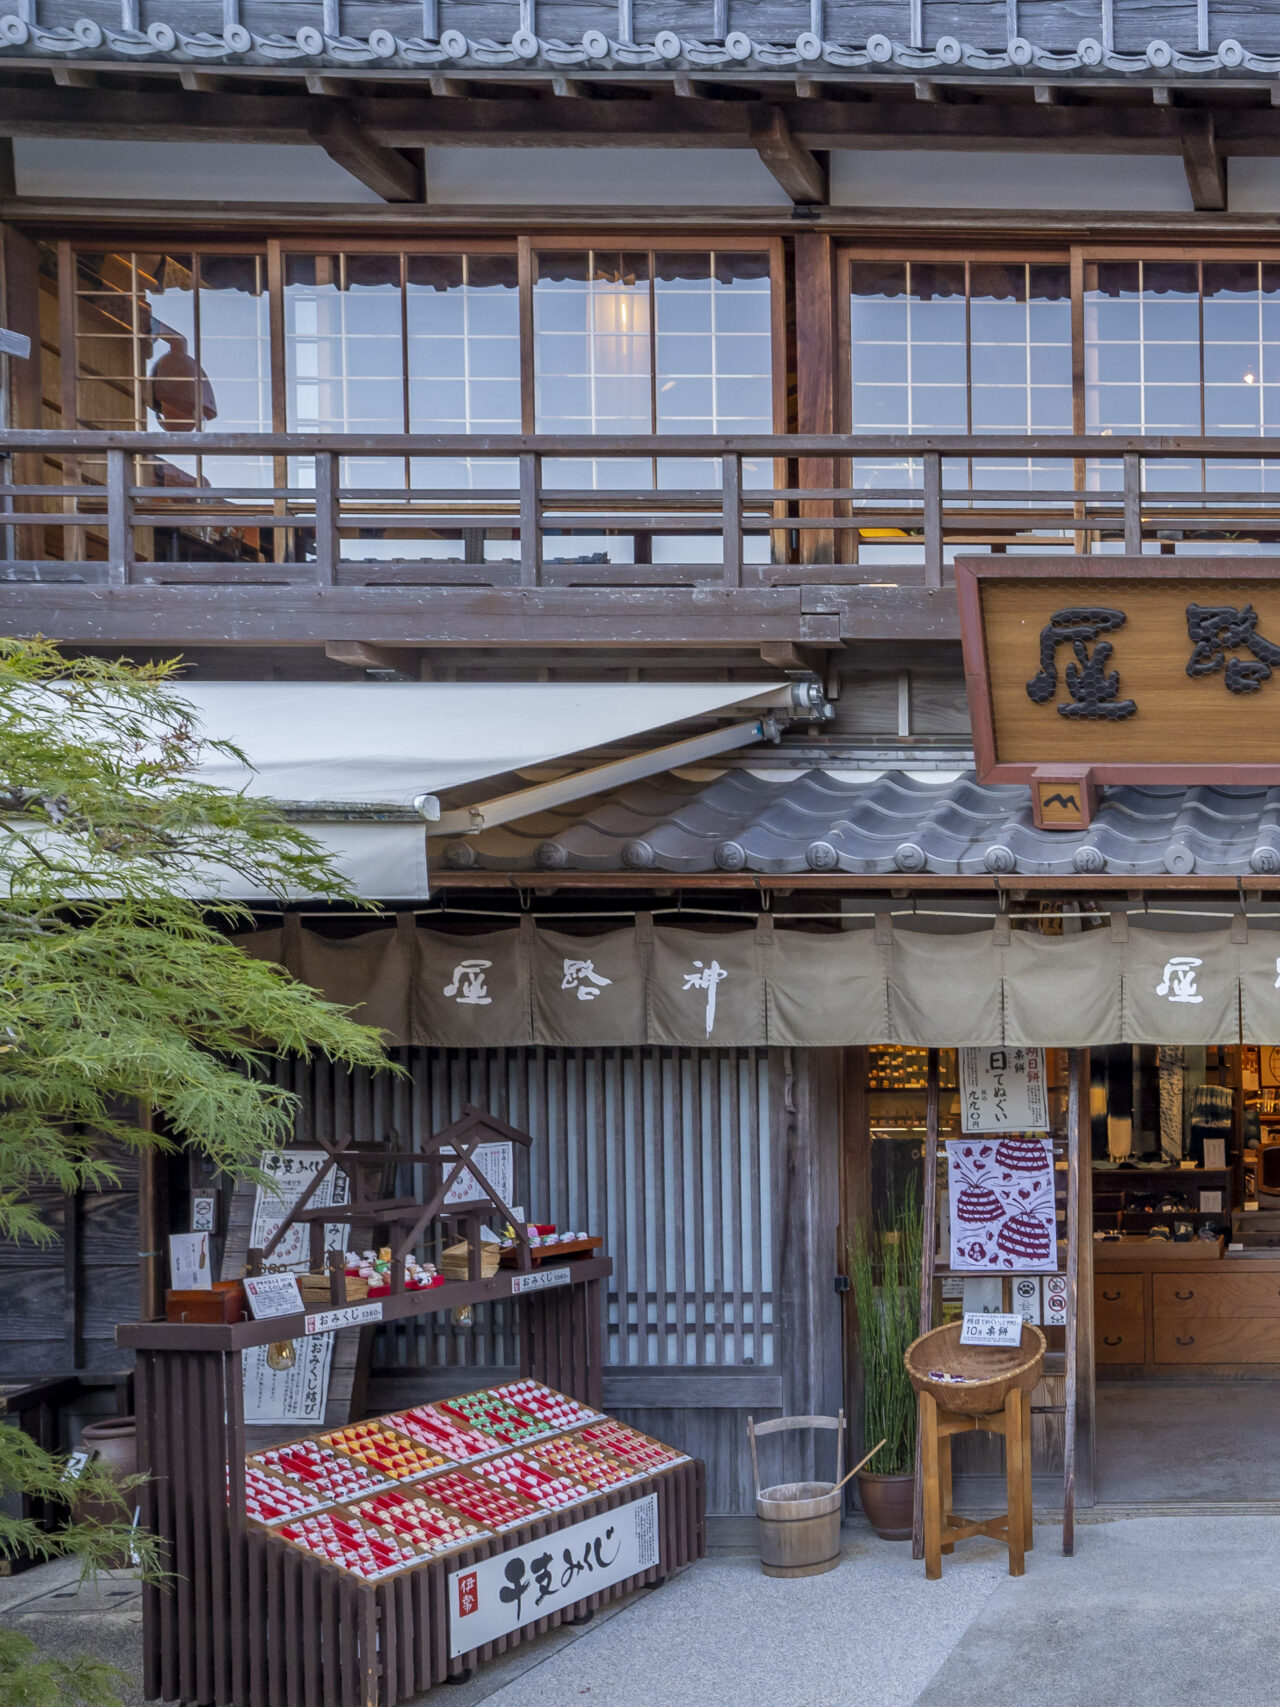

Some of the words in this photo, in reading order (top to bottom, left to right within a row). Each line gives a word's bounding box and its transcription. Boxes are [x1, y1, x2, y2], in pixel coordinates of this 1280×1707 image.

[522, 1272, 553, 1286] おみくじ
[319, 1308, 360, 1326] おみくじ
